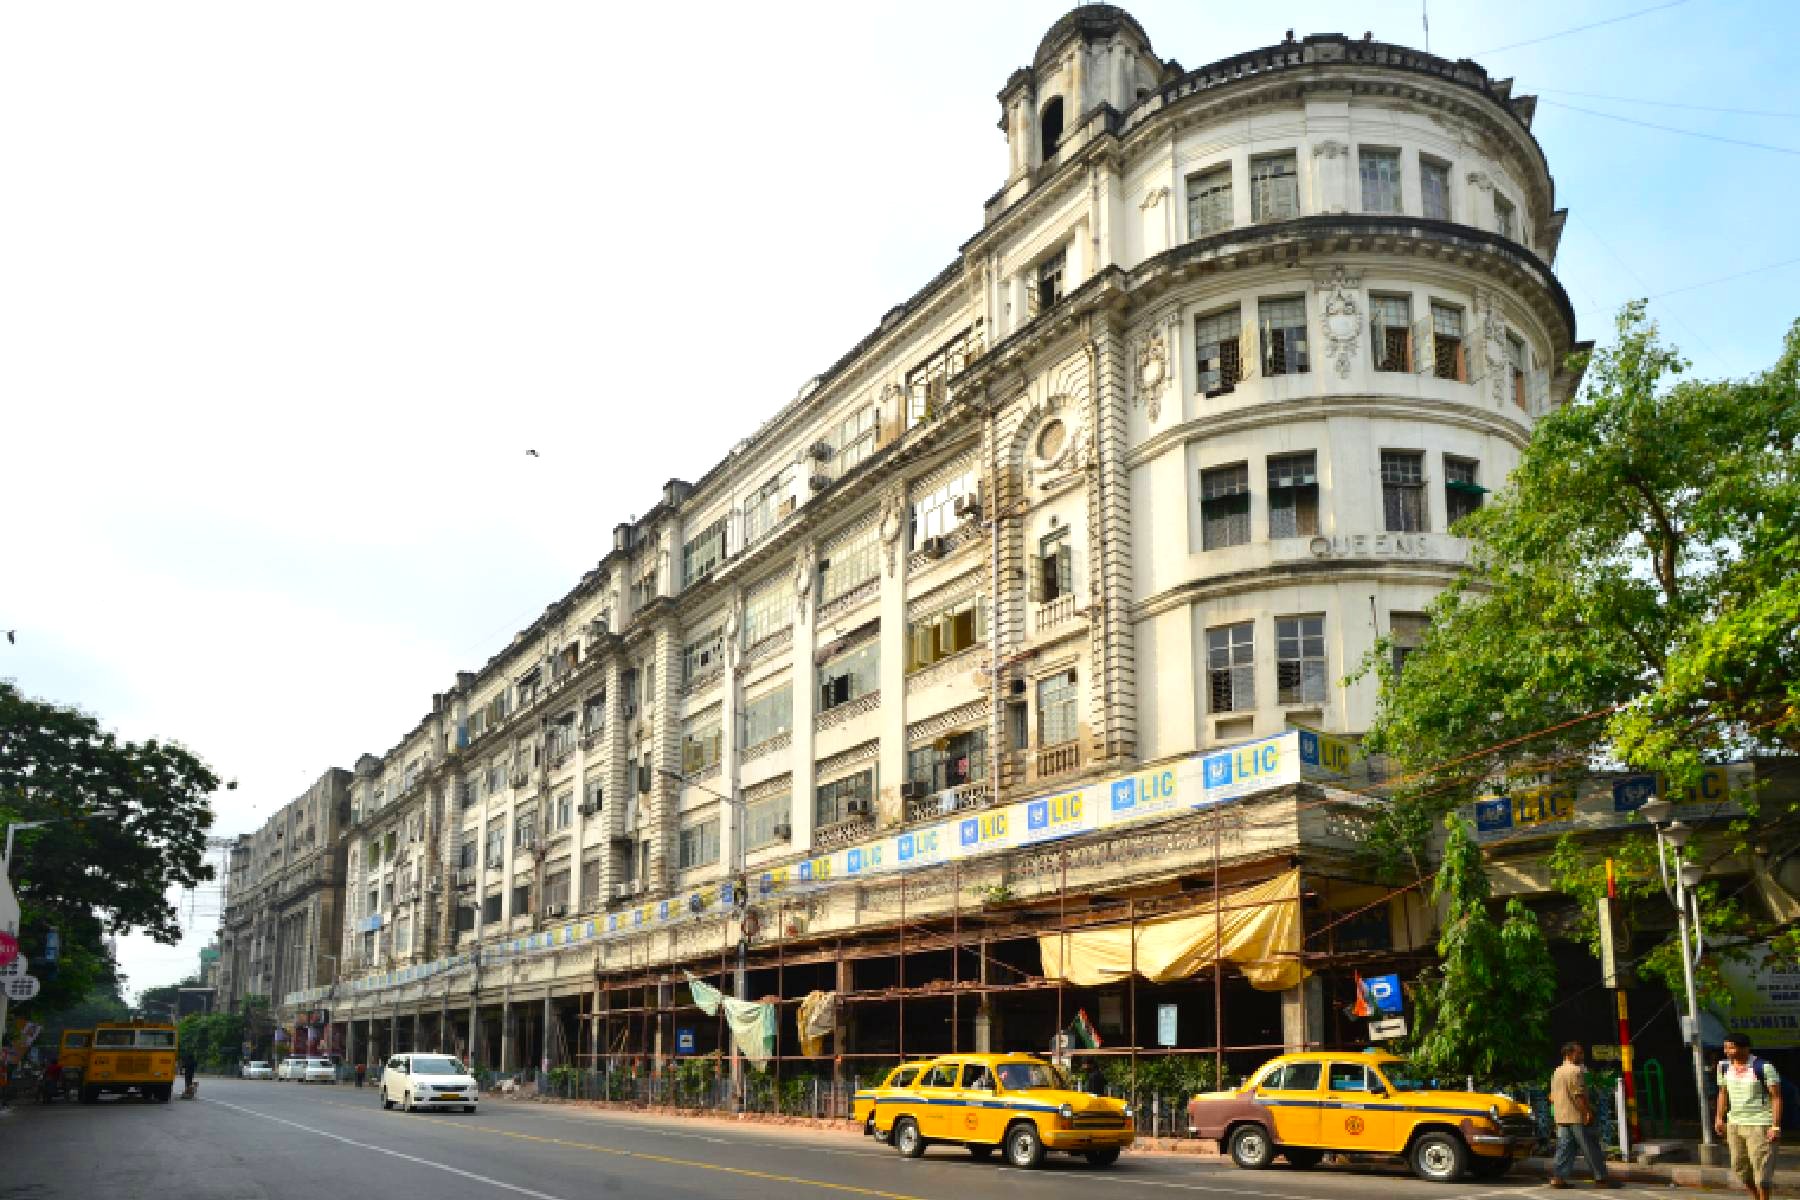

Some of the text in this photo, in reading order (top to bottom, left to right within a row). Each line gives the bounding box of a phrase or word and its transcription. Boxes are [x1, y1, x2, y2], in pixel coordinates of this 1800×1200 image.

[1310, 534, 1427, 558] QUEENS
[1237, 745, 1277, 778] LIC
[1322, 738, 1346, 771] LIC
[1138, 771, 1173, 801] LIC
[1051, 795, 1081, 822] LIC
[1519, 792, 1568, 822] LIC
[981, 814, 1005, 839] LIC
[916, 830, 937, 853] LIC
